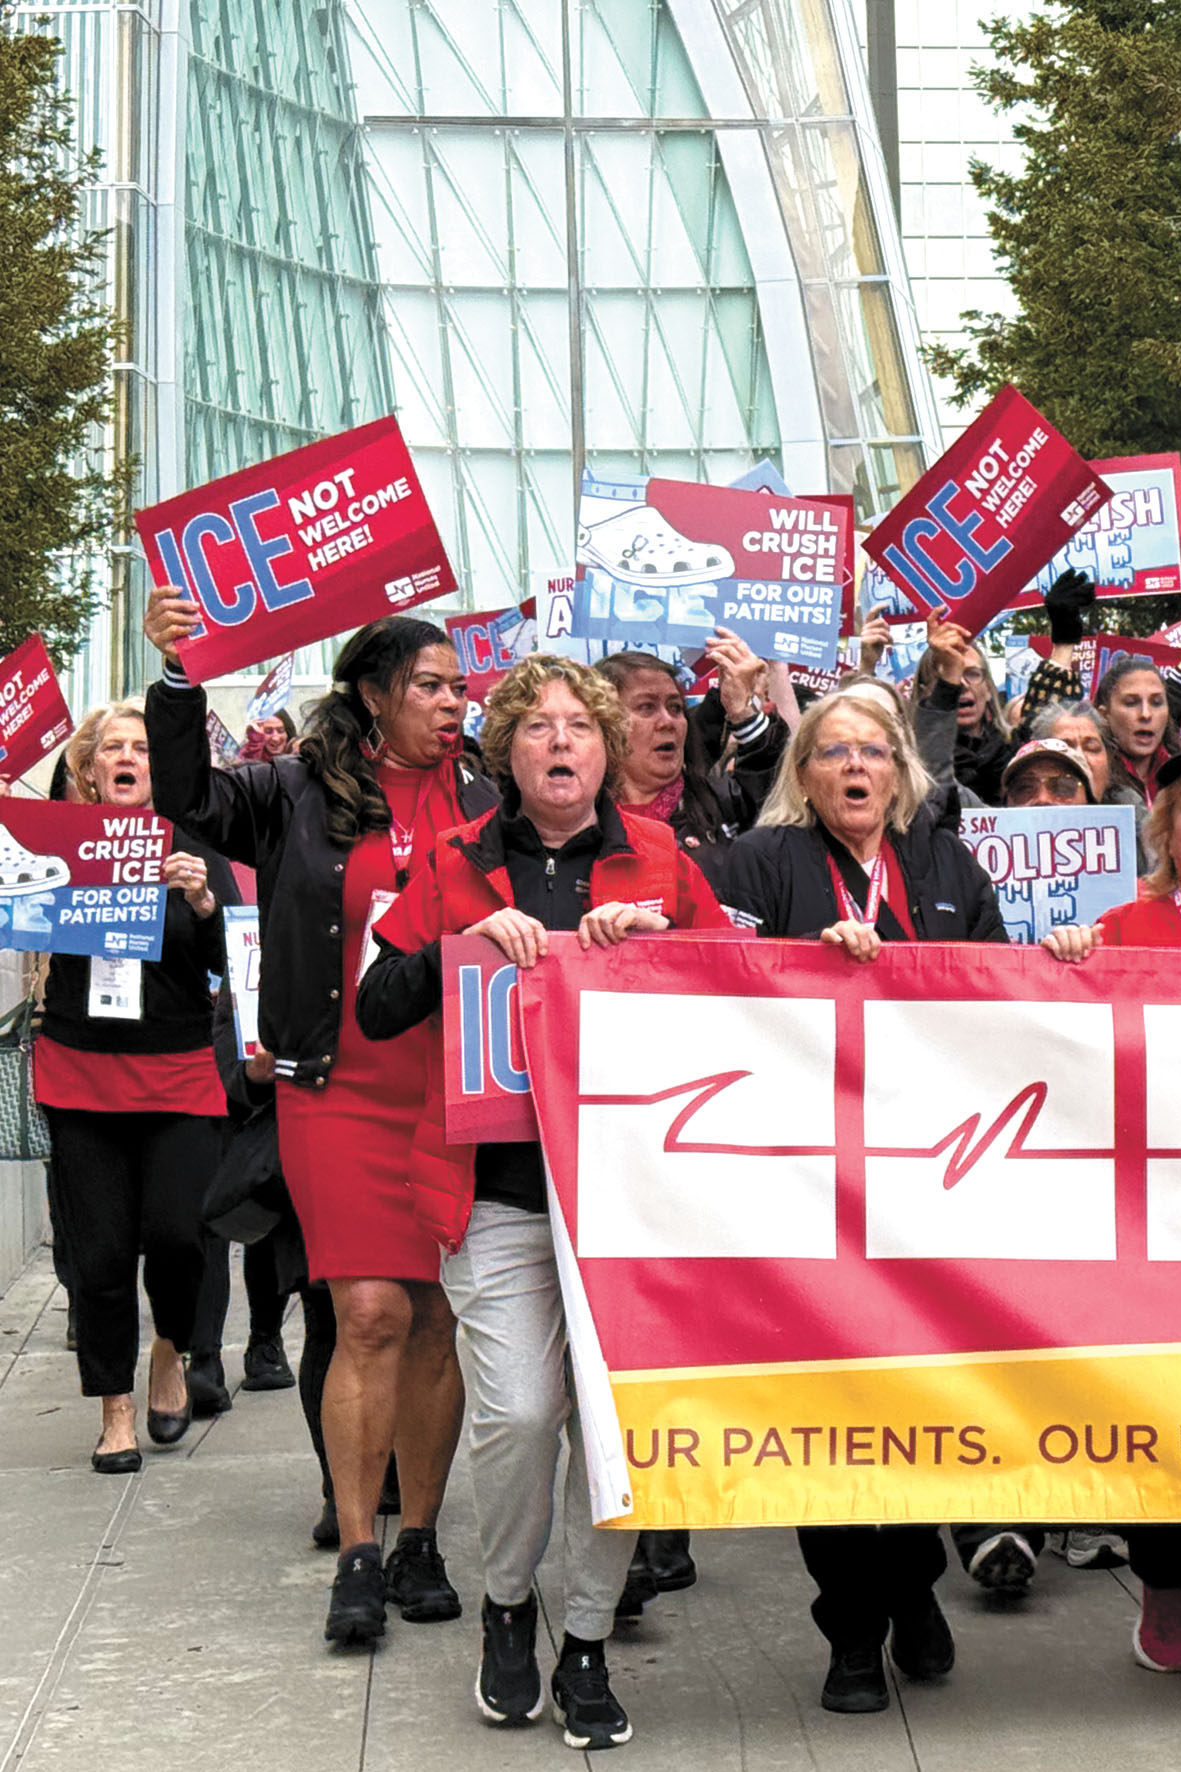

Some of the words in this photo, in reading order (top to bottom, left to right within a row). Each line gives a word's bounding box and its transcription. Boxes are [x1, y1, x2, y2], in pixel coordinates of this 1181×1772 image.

[964, 438, 1009, 499] NOT
[981, 427, 1049, 513] WELCOME
[288, 468, 355, 525] NOT
[298, 477, 412, 547] WELCOME
[995, 476, 1038, 529] HERE!
[769, 509, 838, 532] WILL
[308, 525, 373, 571] HERE!
[742, 531, 837, 556] CRUSH
[883, 479, 1014, 619] ICE
[155, 488, 315, 639] ICE
[781, 556, 835, 582] ICE
[548, 578, 574, 594] NUR
[737, 583, 782, 601] FOR
[787, 585, 833, 605] OUR
[724, 603, 831, 625] PATIENTS!
[0, 671, 24, 706] OT
[2, 703, 34, 741] HERE!
[103, 817, 165, 837] WILL
[971, 816, 997, 833] SAY
[78, 839, 163, 860] CRUSH
[962, 825, 1121, 884] OLISH
[112, 861, 161, 883] ICE
[72, 890, 112, 906] FOR
[117, 888, 159, 904] OUR
[59, 906, 157, 925] PATIENTS!
[459, 963, 533, 1095] IC
[625, 1428, 700, 1468] UR
[723, 1425, 1001, 1468] PATIENTS.
[1038, 1423, 1159, 1464] OUR
